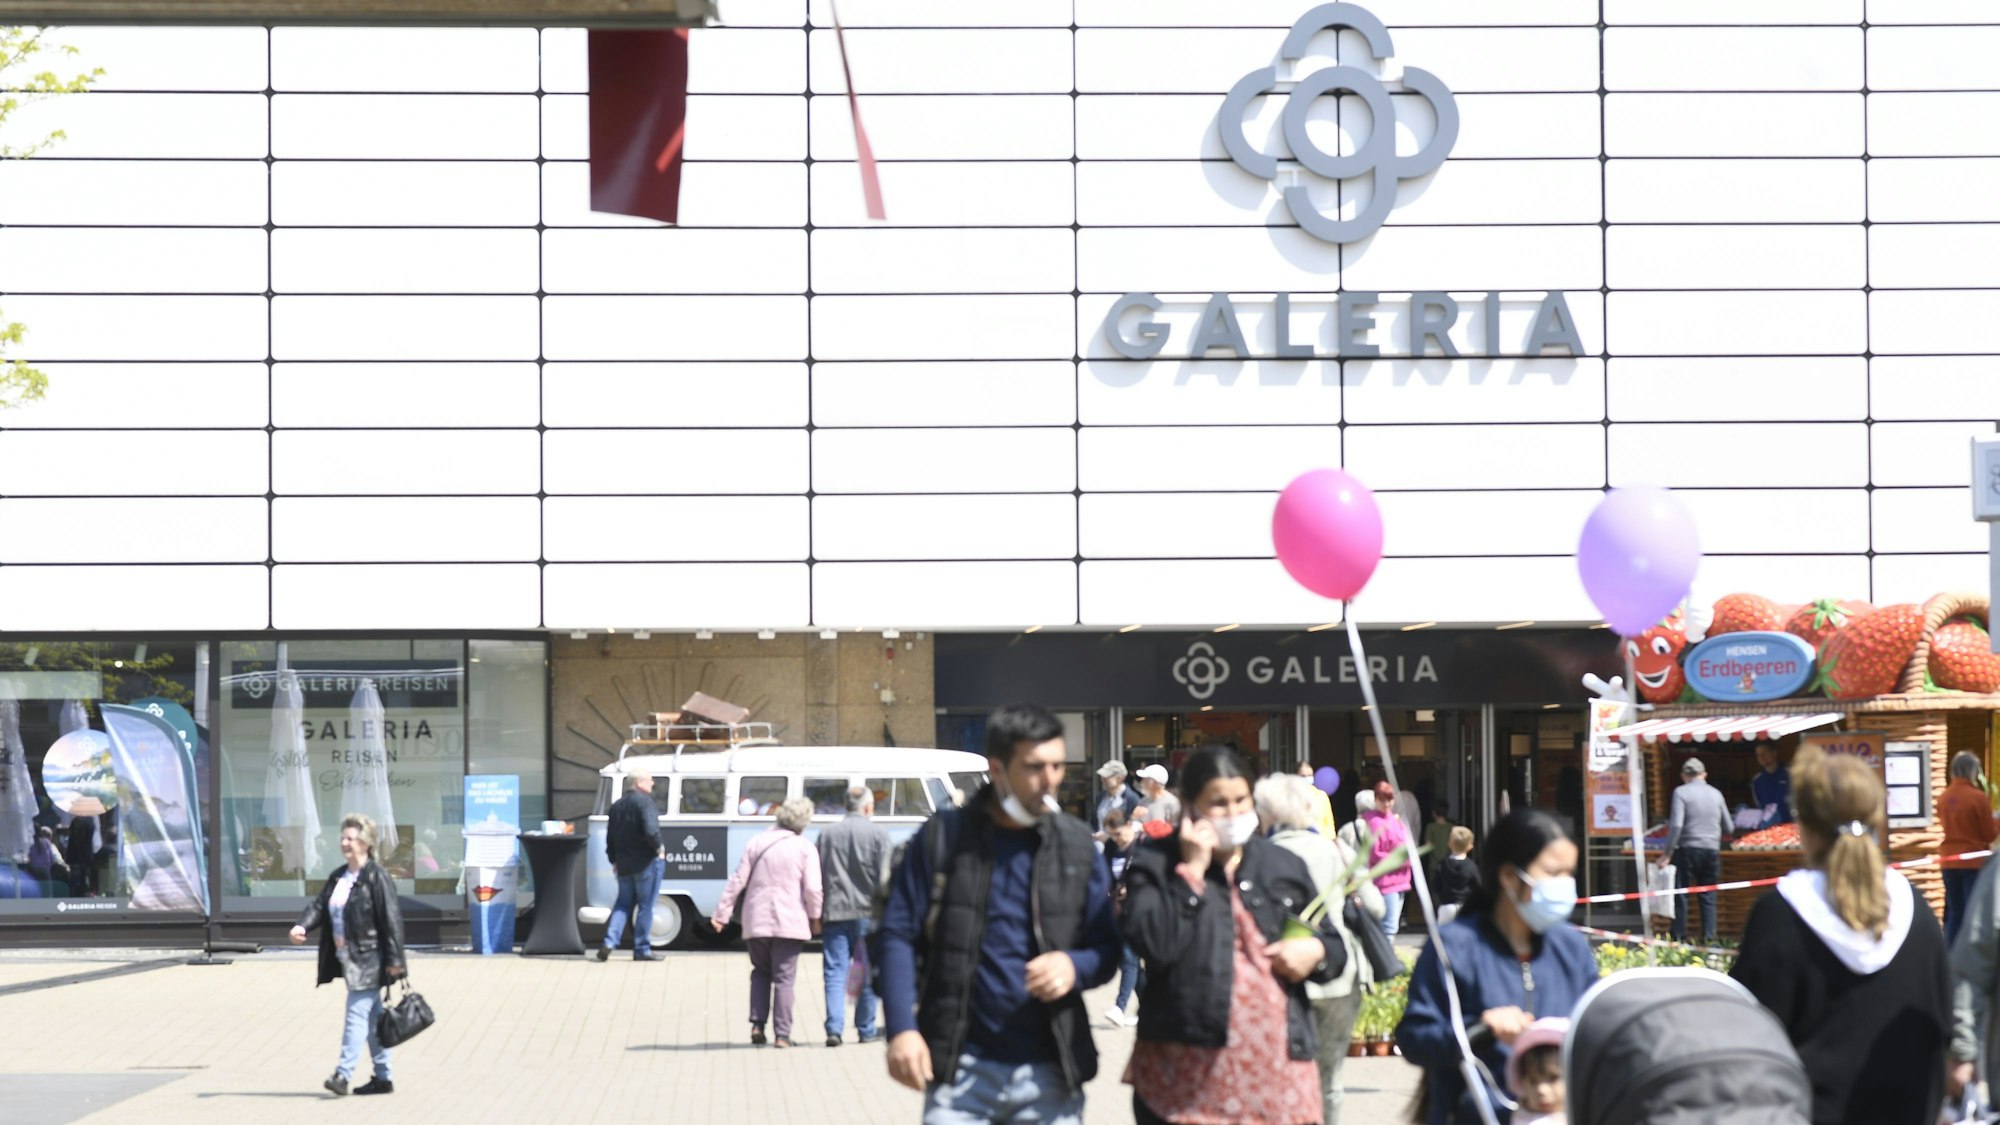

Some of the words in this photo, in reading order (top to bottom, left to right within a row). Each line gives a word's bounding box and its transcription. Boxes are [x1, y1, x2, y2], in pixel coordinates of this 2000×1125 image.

[1105, 291, 1586, 359] GALERIA
[1726, 645, 1768, 657] HENSEN
[1246, 655, 1439, 684] GALERIA
[1699, 659, 1797, 678] Erdbeeren
[278, 677, 374, 691] GALERIA
[380, 677, 449, 690] REISEN
[299, 719, 433, 740] GALERIA
[331, 750, 398, 763] REISEN
[665, 852, 715, 863] GALERIA
